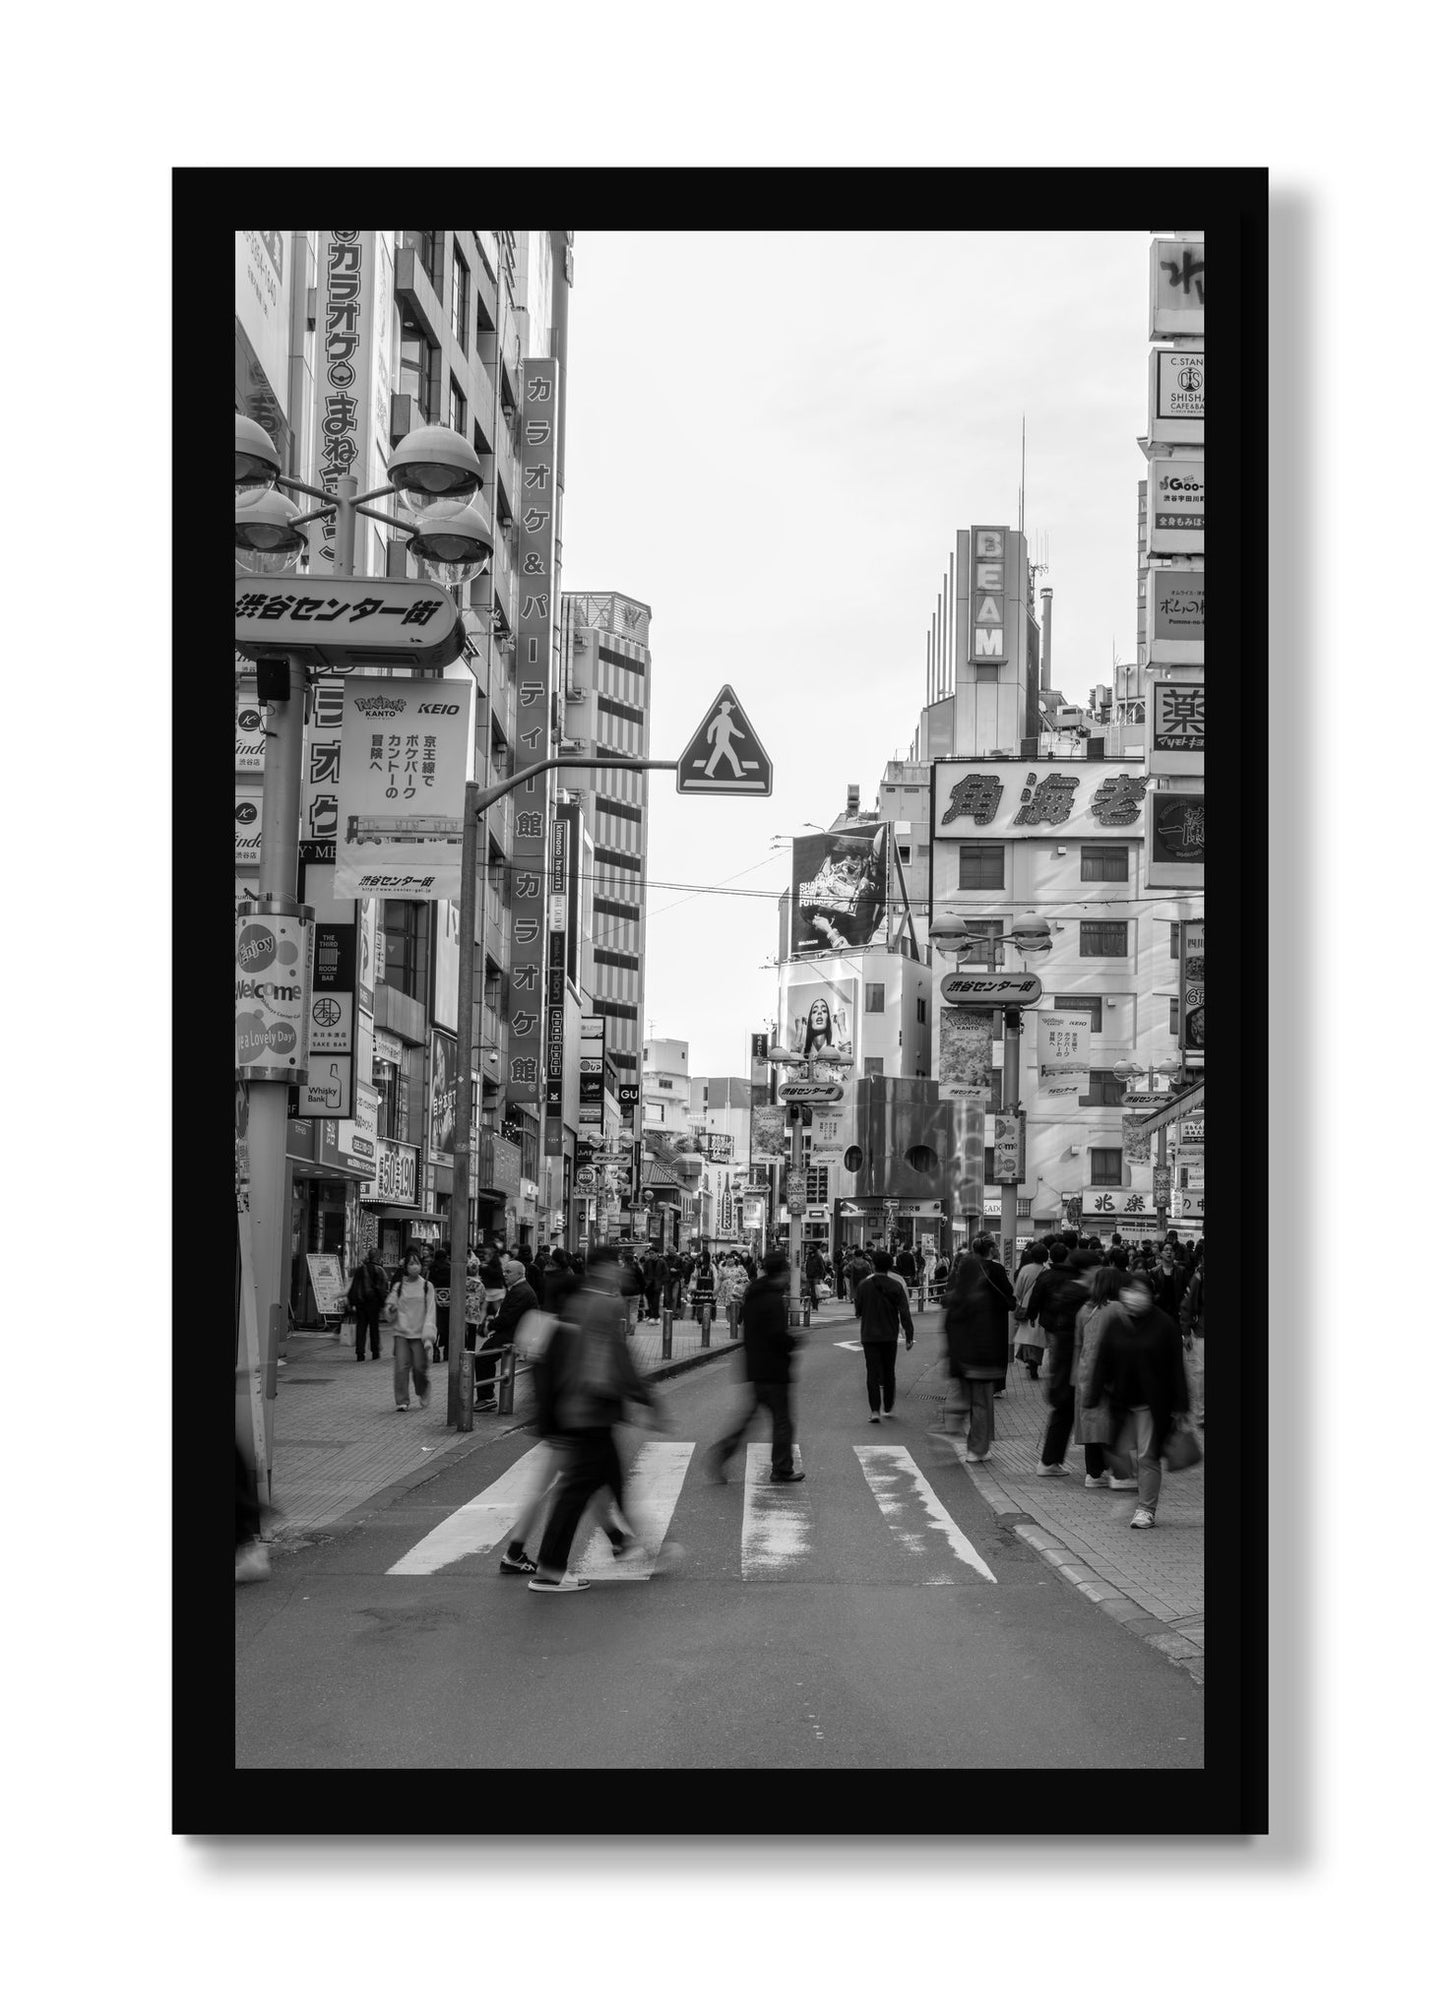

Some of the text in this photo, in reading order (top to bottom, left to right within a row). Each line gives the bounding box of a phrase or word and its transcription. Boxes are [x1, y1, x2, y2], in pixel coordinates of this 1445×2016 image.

[326, 242, 363, 363] カラオケ
[1159, 516, 1204, 527] 全身もみほ
[975, 531, 1005, 656] BEAM
[236, 592, 444, 627] 渋谷センター街
[365, 710, 396, 718] KANTO
[417, 703, 461, 716] KEIO
[1162, 689, 1205, 734] 薬
[510, 377, 552, 1084] カラオケ&パーティー館 カラオケ館
[369, 734, 384, 773] 冒険へ
[421, 734, 437, 788] 京王線で
[385, 734, 401, 800] カントーの
[942, 772, 1148, 826] 角海老
[554, 824, 565, 890] kimono hearts
[359, 875, 437, 889] 渋谷センター街
[239, 936, 275, 966] Enjoy
[236, 979, 302, 1001] Welcome
[947, 980, 1037, 993] 渋谷センター街
[250, 1029, 277, 1047] Lovely
[278, 1031, 296, 1043] Day!
[307, 1094, 326, 1103] Bank
[308, 1086, 338, 1097] Whisky
[620, 1089, 638, 1100] GU
[1094, 1193, 1146, 1213] 兆楽
